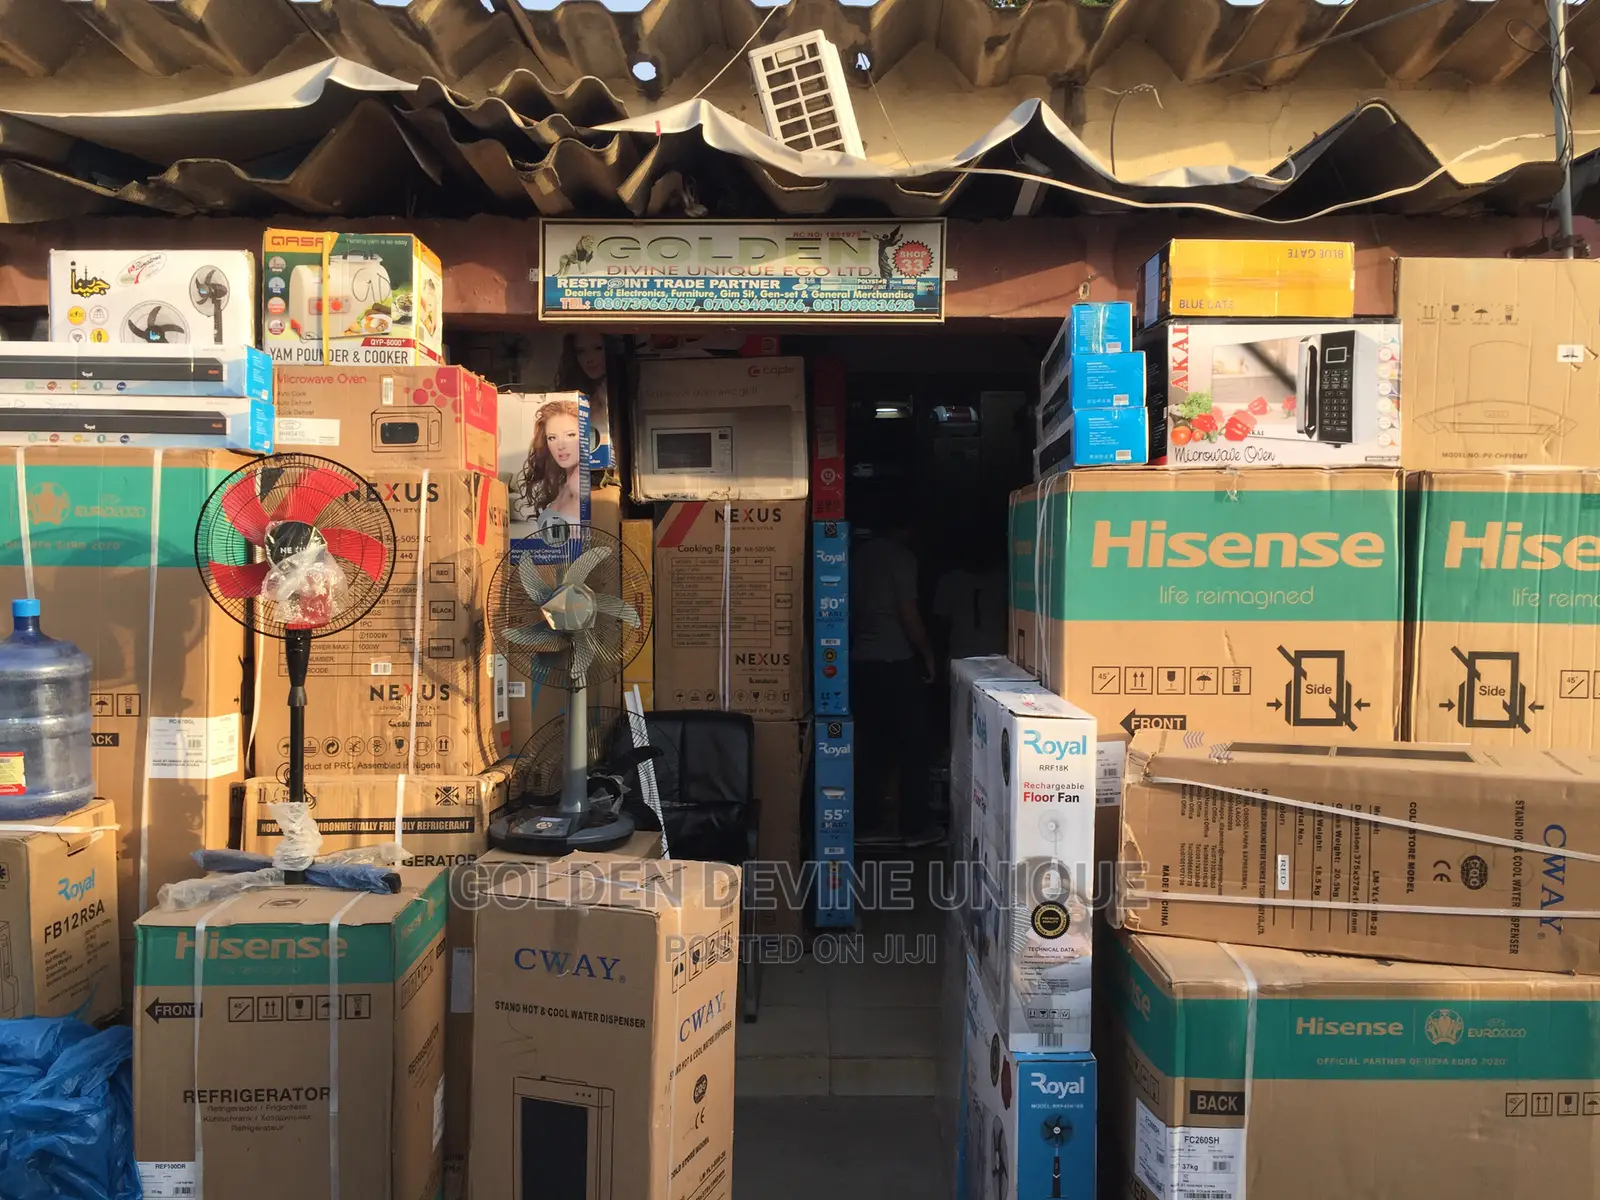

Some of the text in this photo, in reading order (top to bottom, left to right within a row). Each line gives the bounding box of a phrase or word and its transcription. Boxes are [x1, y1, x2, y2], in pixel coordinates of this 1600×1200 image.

[597, 236, 870, 266] GOLDEN
[1287, 248, 1345, 259] BLUE GATE
[606, 265, 877, 277] DIVINE UNIQUE EGO LTD.
[901, 259, 924, 272] 33
[654, 278, 705, 288] TRADE
[710, 278, 780, 289] PARTNER
[565, 289, 601, 297] Dealers
[604, 289, 614, 297] of
[616, 289, 669, 298] Electronics,
[671, 289, 717, 299] Furniture,
[760, 290, 799, 299] Gen-set
[811, 291, 850, 299] General
[853, 291, 914, 299] Merchandise
[560, 297, 591, 310] TEL:
[1179, 299, 1234, 309] BLUE GATE
[270, 347, 293, 361] YAM
[352, 350, 361, 363] &
[364, 350, 408, 364] COOKER
[1171, 323, 1190, 392] AKAI
[337, 373, 367, 385] Oven
[1174, 445, 1276, 464] Microwave Oven
[344, 482, 439, 503] NEXUS
[714, 508, 782, 523] NEXUS
[678, 544, 742, 555] Cooking Rage
[1091, 520, 1385, 569] Hisense
[1444, 520, 1600, 572] Hise
[816, 550, 846, 564] Royal
[1159, 584, 1315, 610] life reimagined
[1512, 588, 1541, 607] life
[735, 653, 791, 666] NEXUS
[1304, 683, 1333, 695] Side
[1478, 685, 1506, 697] Side
[1130, 717, 1184, 731] FRONT
[91, 734, 113, 745] ACK
[1023, 729, 1087, 761] Royal
[818, 742, 851, 757] Royal
[321, 760, 332, 770] of
[357, 760, 402, 771] Assembled
[1039, 764, 1069, 772] RRF18K
[1023, 782, 1085, 791] Rechargeable
[1023, 791, 1080, 803] Floor Fan
[1279, 802, 1287, 826] olor:
[1514, 800, 1525, 827] STAND
[260, 822, 280, 832] NOW
[417, 819, 470, 831] REFRIGERANT
[1514, 829, 1524, 847] HO
[1313, 820, 1323, 896] Weight: 18.5 kg
[1332, 830, 1342, 898] Weight: 20.5kg
[1512, 855, 1523, 879] COOL
[58, 868, 95, 902] Royal
[1406, 862, 1415, 894] MODEL
[1539, 823, 1567, 935] CWAY
[1161, 864, 1170, 927] MADE CHINA
[1511, 880, 1522, 908] WATER
[44, 899, 105, 944] FB12RSA
[174, 931, 348, 960] Hisense
[513, 947, 621, 981] CWAY
[154, 1004, 201, 1017] FRONT
[494, 1000, 646, 1029] STAND HOT & COOL WATER DISPENSER
[678, 989, 725, 1043] CWAY
[1295, 1016, 1404, 1037] Hisense
[1467, 1027, 1527, 1038] EURO2020
[1316, 1057, 1360, 1066] OFFICIAL
[1363, 1057, 1406, 1066] PARTNER
[1409, 1057, 1422, 1066] OF
[1452, 1057, 1478, 1066] EURO
[1481, 1057, 1507, 1066] 2020
[1030, 1072, 1085, 1099] Royal
[183, 1086, 331, 1104] REFRIGERATOR
[1197, 1095, 1239, 1111] BACK
[1184, 1135, 1220, 1145] FC260SH
